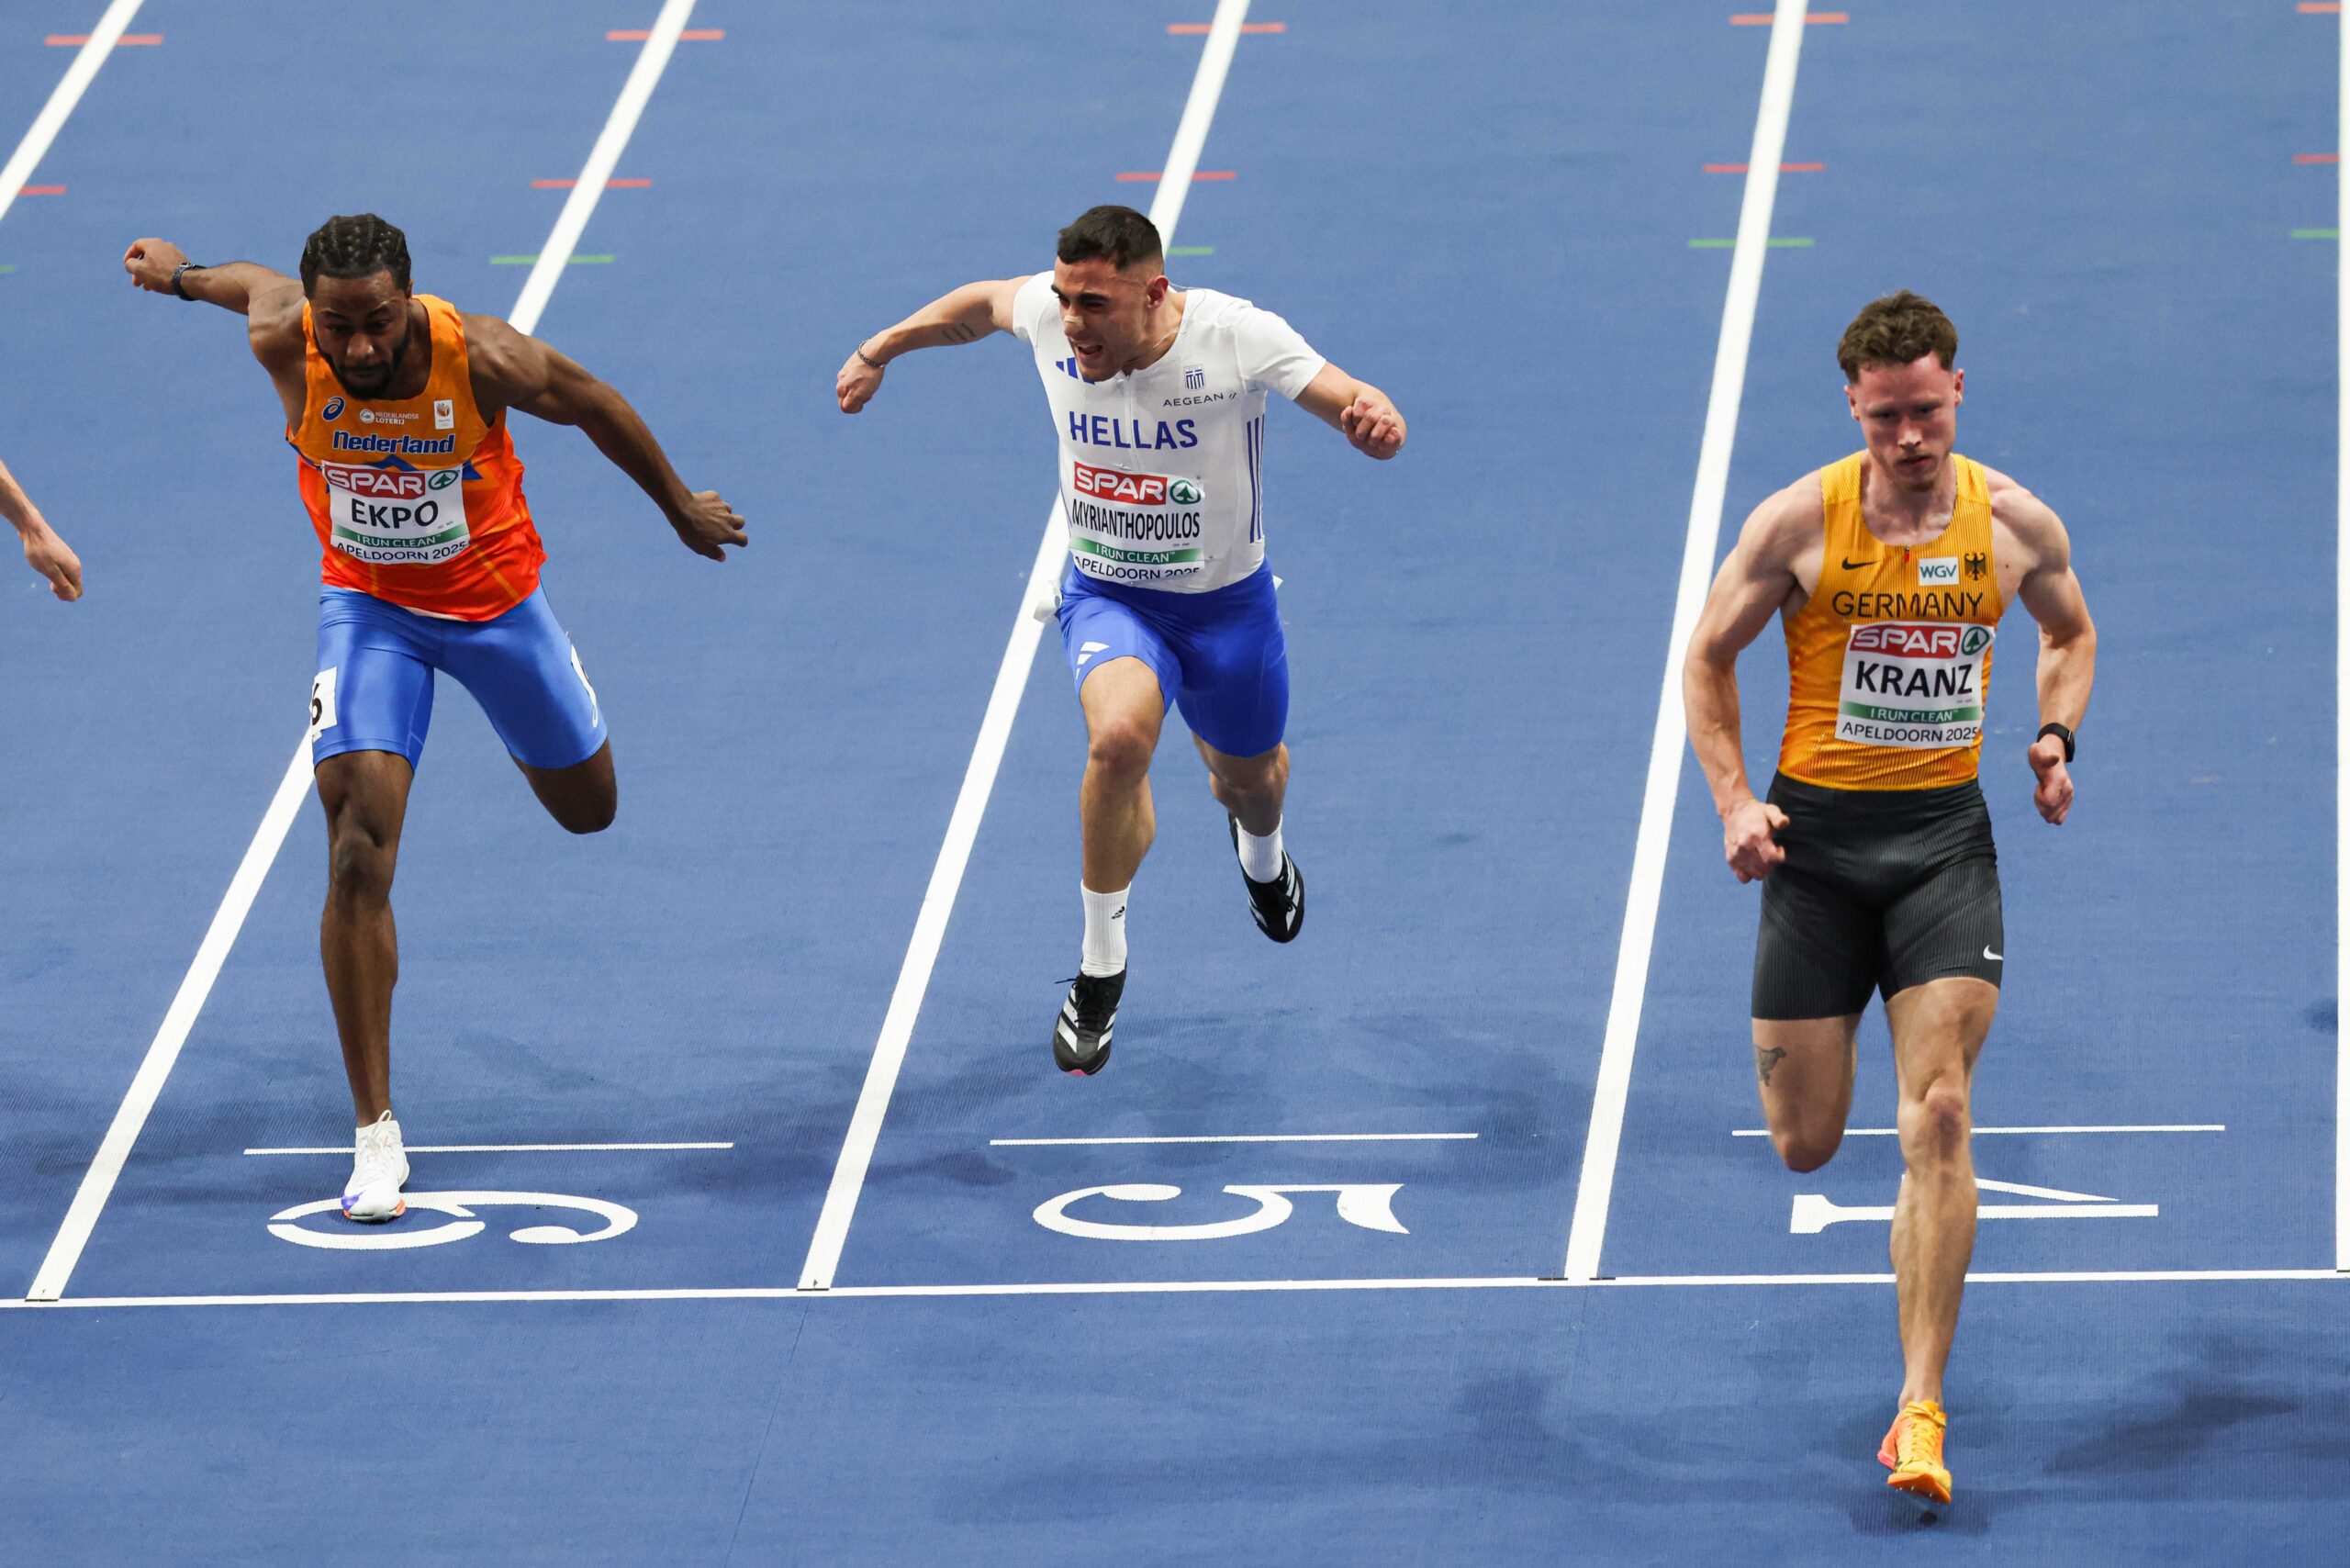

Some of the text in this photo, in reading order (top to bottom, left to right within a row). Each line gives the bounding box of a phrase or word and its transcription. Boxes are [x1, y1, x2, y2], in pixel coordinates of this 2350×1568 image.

[1162, 393, 1224, 408] AEGEAN
[375, 411, 420, 420] NEDERLANDSE
[375, 417, 405, 425] LOTERIJ
[331, 430, 456, 454] Nederland
[1069, 410, 1199, 450] HELLAS
[326, 469, 424, 496] SPAR
[1076, 467, 1165, 501] SPAR
[351, 498, 439, 530] EKPO
[1072, 498, 1201, 541] MYRIANTHOPOULOS
[337, 541, 466, 561] APELDOORN 2025
[357, 533, 361, 543] I
[363, 536, 390, 547] RUN
[1096, 543, 1100, 554] I
[1101, 545, 1125, 560] RUN
[1919, 565, 1958, 579] WGV
[1831, 590, 1984, 618] GERMANY
[1852, 628, 1957, 655] SPAR
[1854, 660, 1974, 699] KRANZ
[1870, 708, 1874, 719] I
[1877, 708, 1908, 722] RUN
[1841, 722, 1943, 742] APELDOORN
[266, 1190, 639, 1250] 6
[1032, 1182, 1411, 1241] 5
